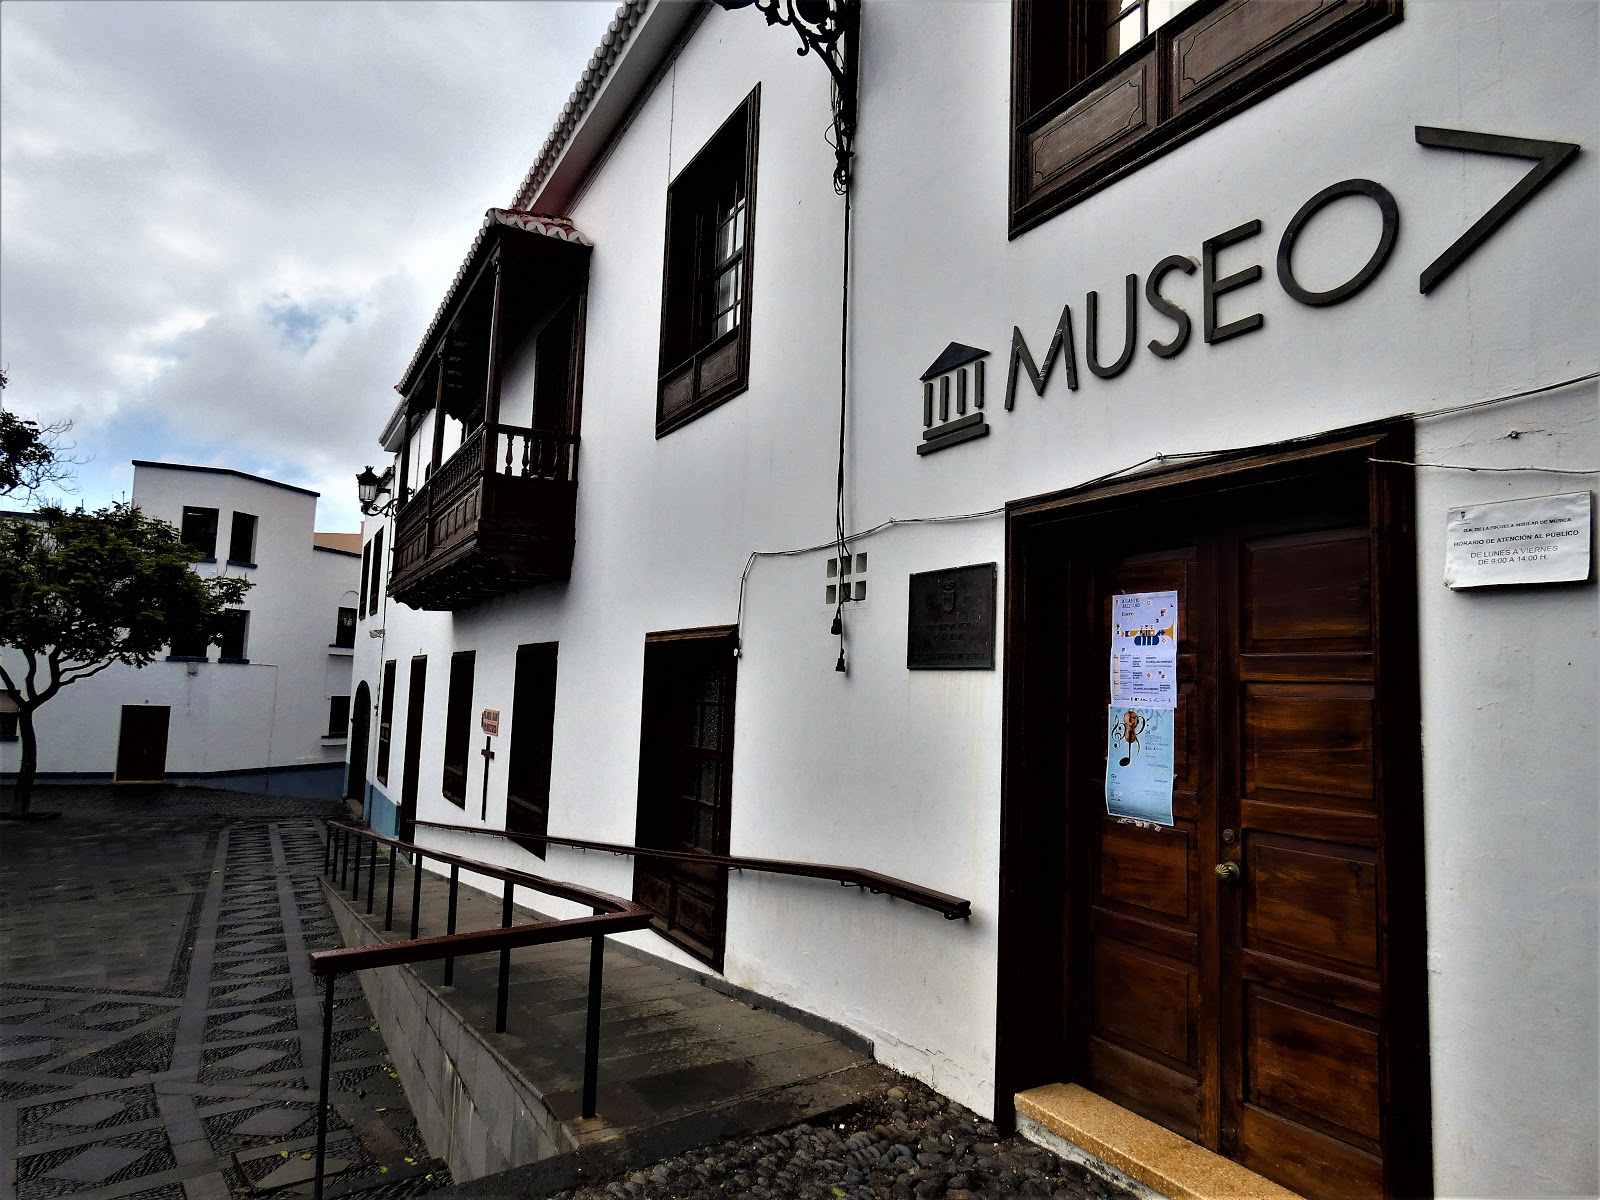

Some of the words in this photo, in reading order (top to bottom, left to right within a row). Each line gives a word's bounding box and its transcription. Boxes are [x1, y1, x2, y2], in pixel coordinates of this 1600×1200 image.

[1004, 178, 1400, 412] MUSEO
[1454, 539, 1485, 547] HORARIO
[1496, 534, 1533, 544] ATENCIÓN
[1533, 532, 1544, 540] AL
[1545, 529, 1579, 538] PÚBLICO
[1470, 551, 1482, 559] DE
[1483, 549, 1511, 558] LUNES
[1520, 545, 1558, 555] VIERNES
[1517, 554, 1538, 562] 14:00
